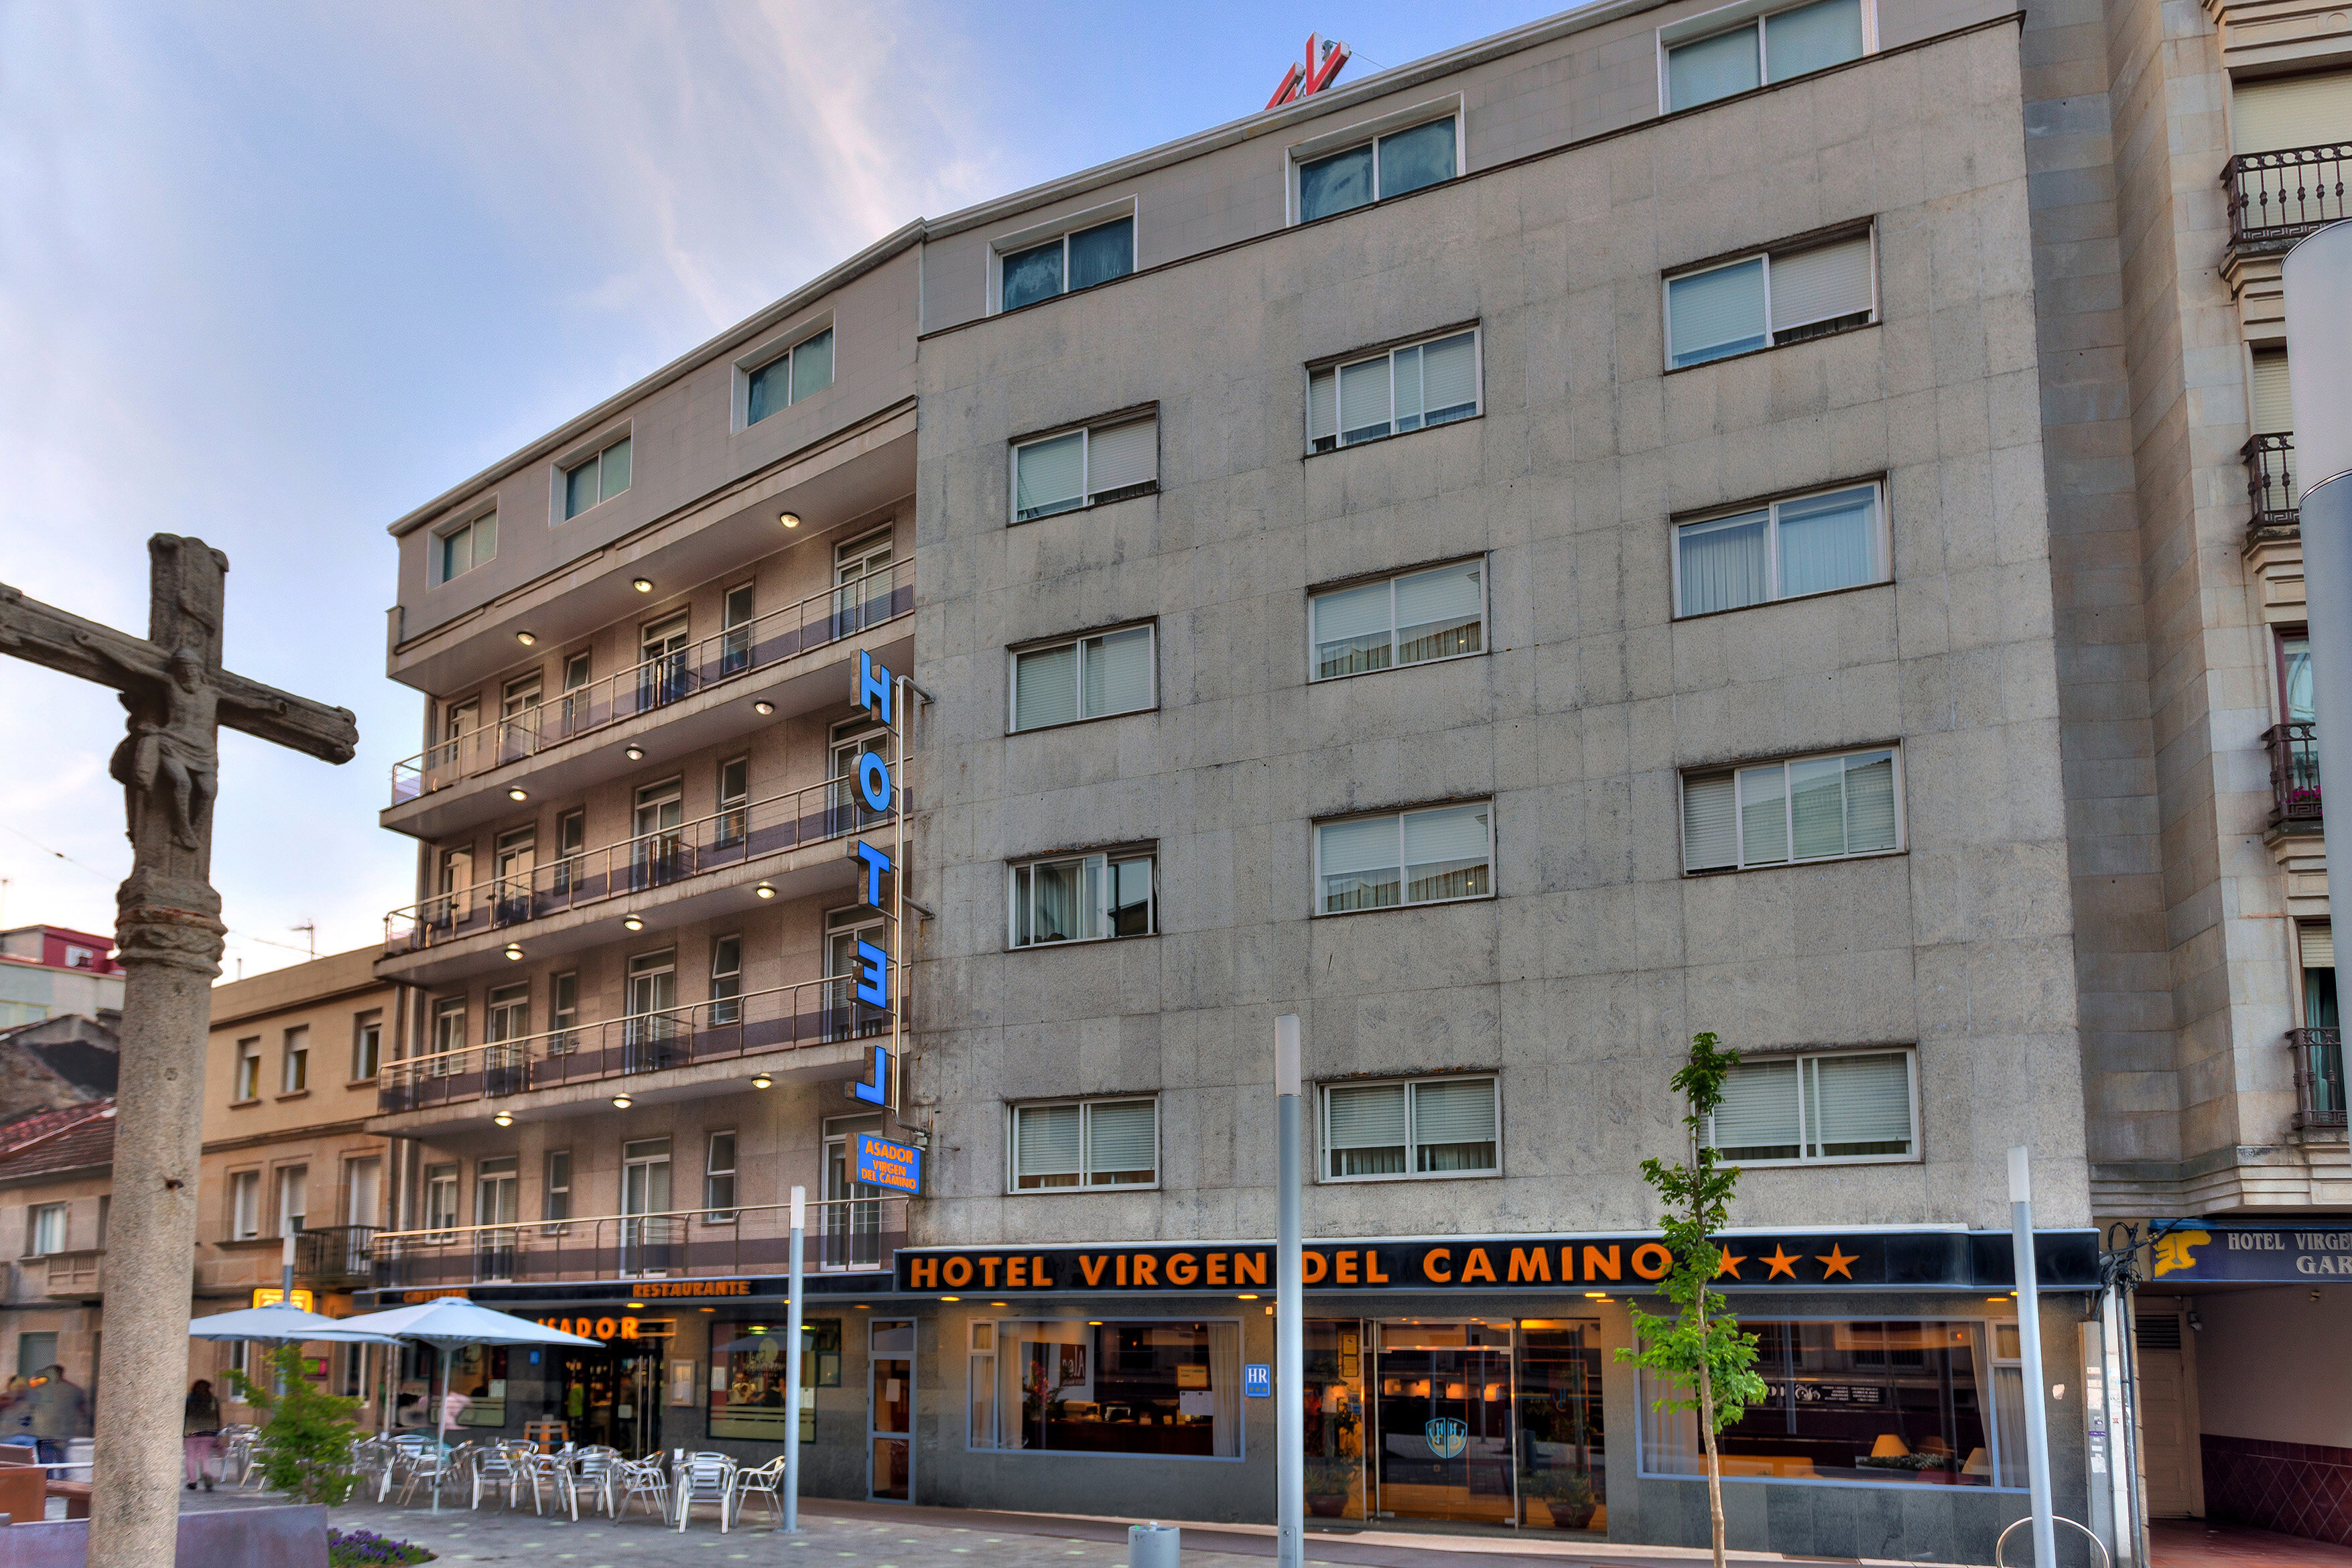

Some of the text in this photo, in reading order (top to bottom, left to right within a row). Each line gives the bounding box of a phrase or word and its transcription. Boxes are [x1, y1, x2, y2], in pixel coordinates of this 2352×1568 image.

[865, 1140, 913, 1165] ASADOR
[872, 1159, 906, 1177] VIRGEN
[861, 1167, 917, 1190] DEL CAMINO
[2227, 1232, 2352, 1250] HOTEL VIRGE
[911, 1243, 1674, 1288] HOTEL VIRGEN DEL CAMINO
[633, 1281, 750, 1298] RESTAURANTE
[1248, 1368, 1268, 1384] HR
